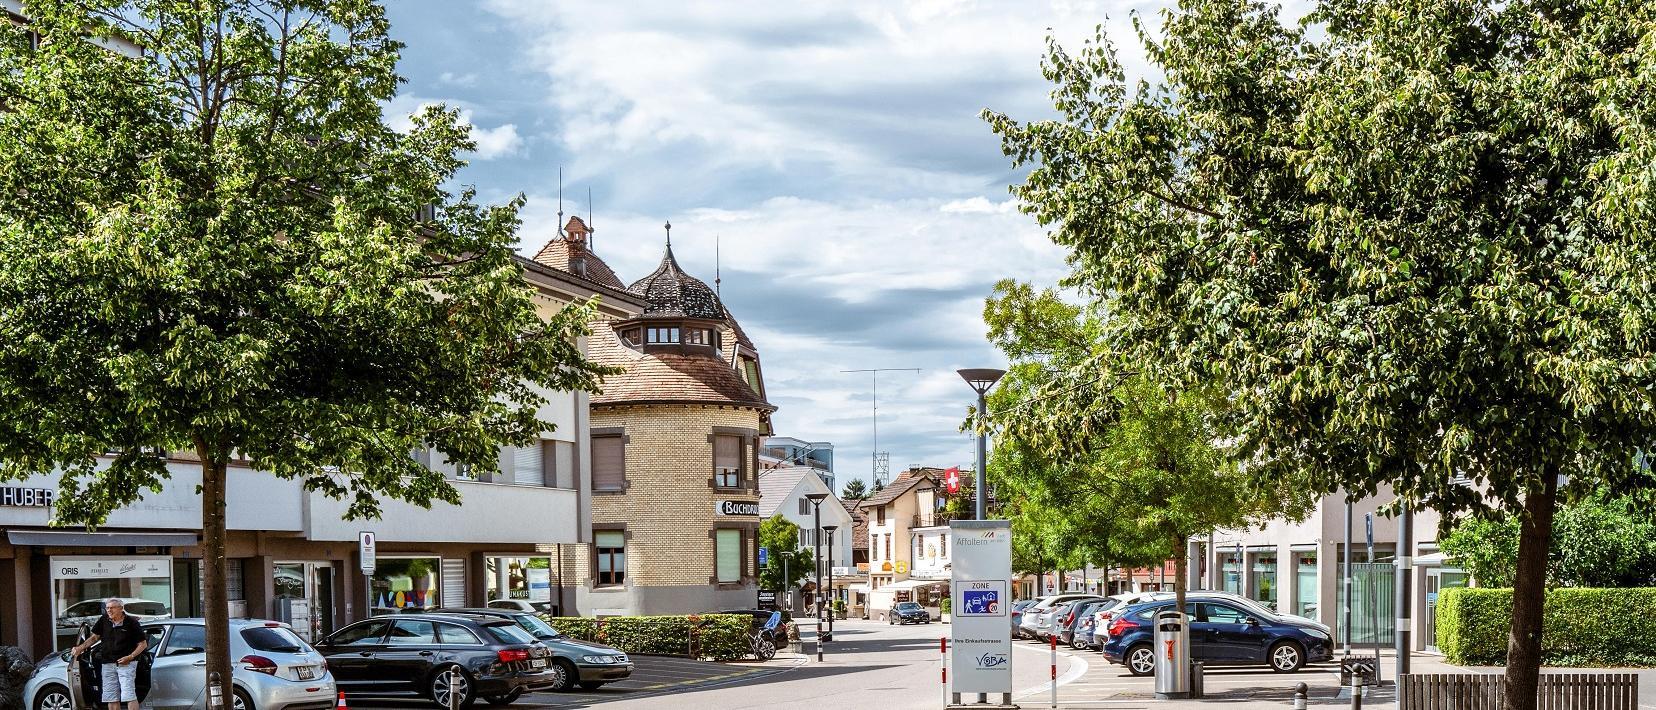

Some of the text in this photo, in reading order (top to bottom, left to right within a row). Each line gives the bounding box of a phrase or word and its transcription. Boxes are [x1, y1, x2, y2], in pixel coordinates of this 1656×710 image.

[3, 487, 54, 507] HUBER
[956, 537, 988, 546] Affoltern
[61, 567, 79, 576] ORIS
[971, 582, 990, 590] ZONE
[991, 604, 998, 612] 20
